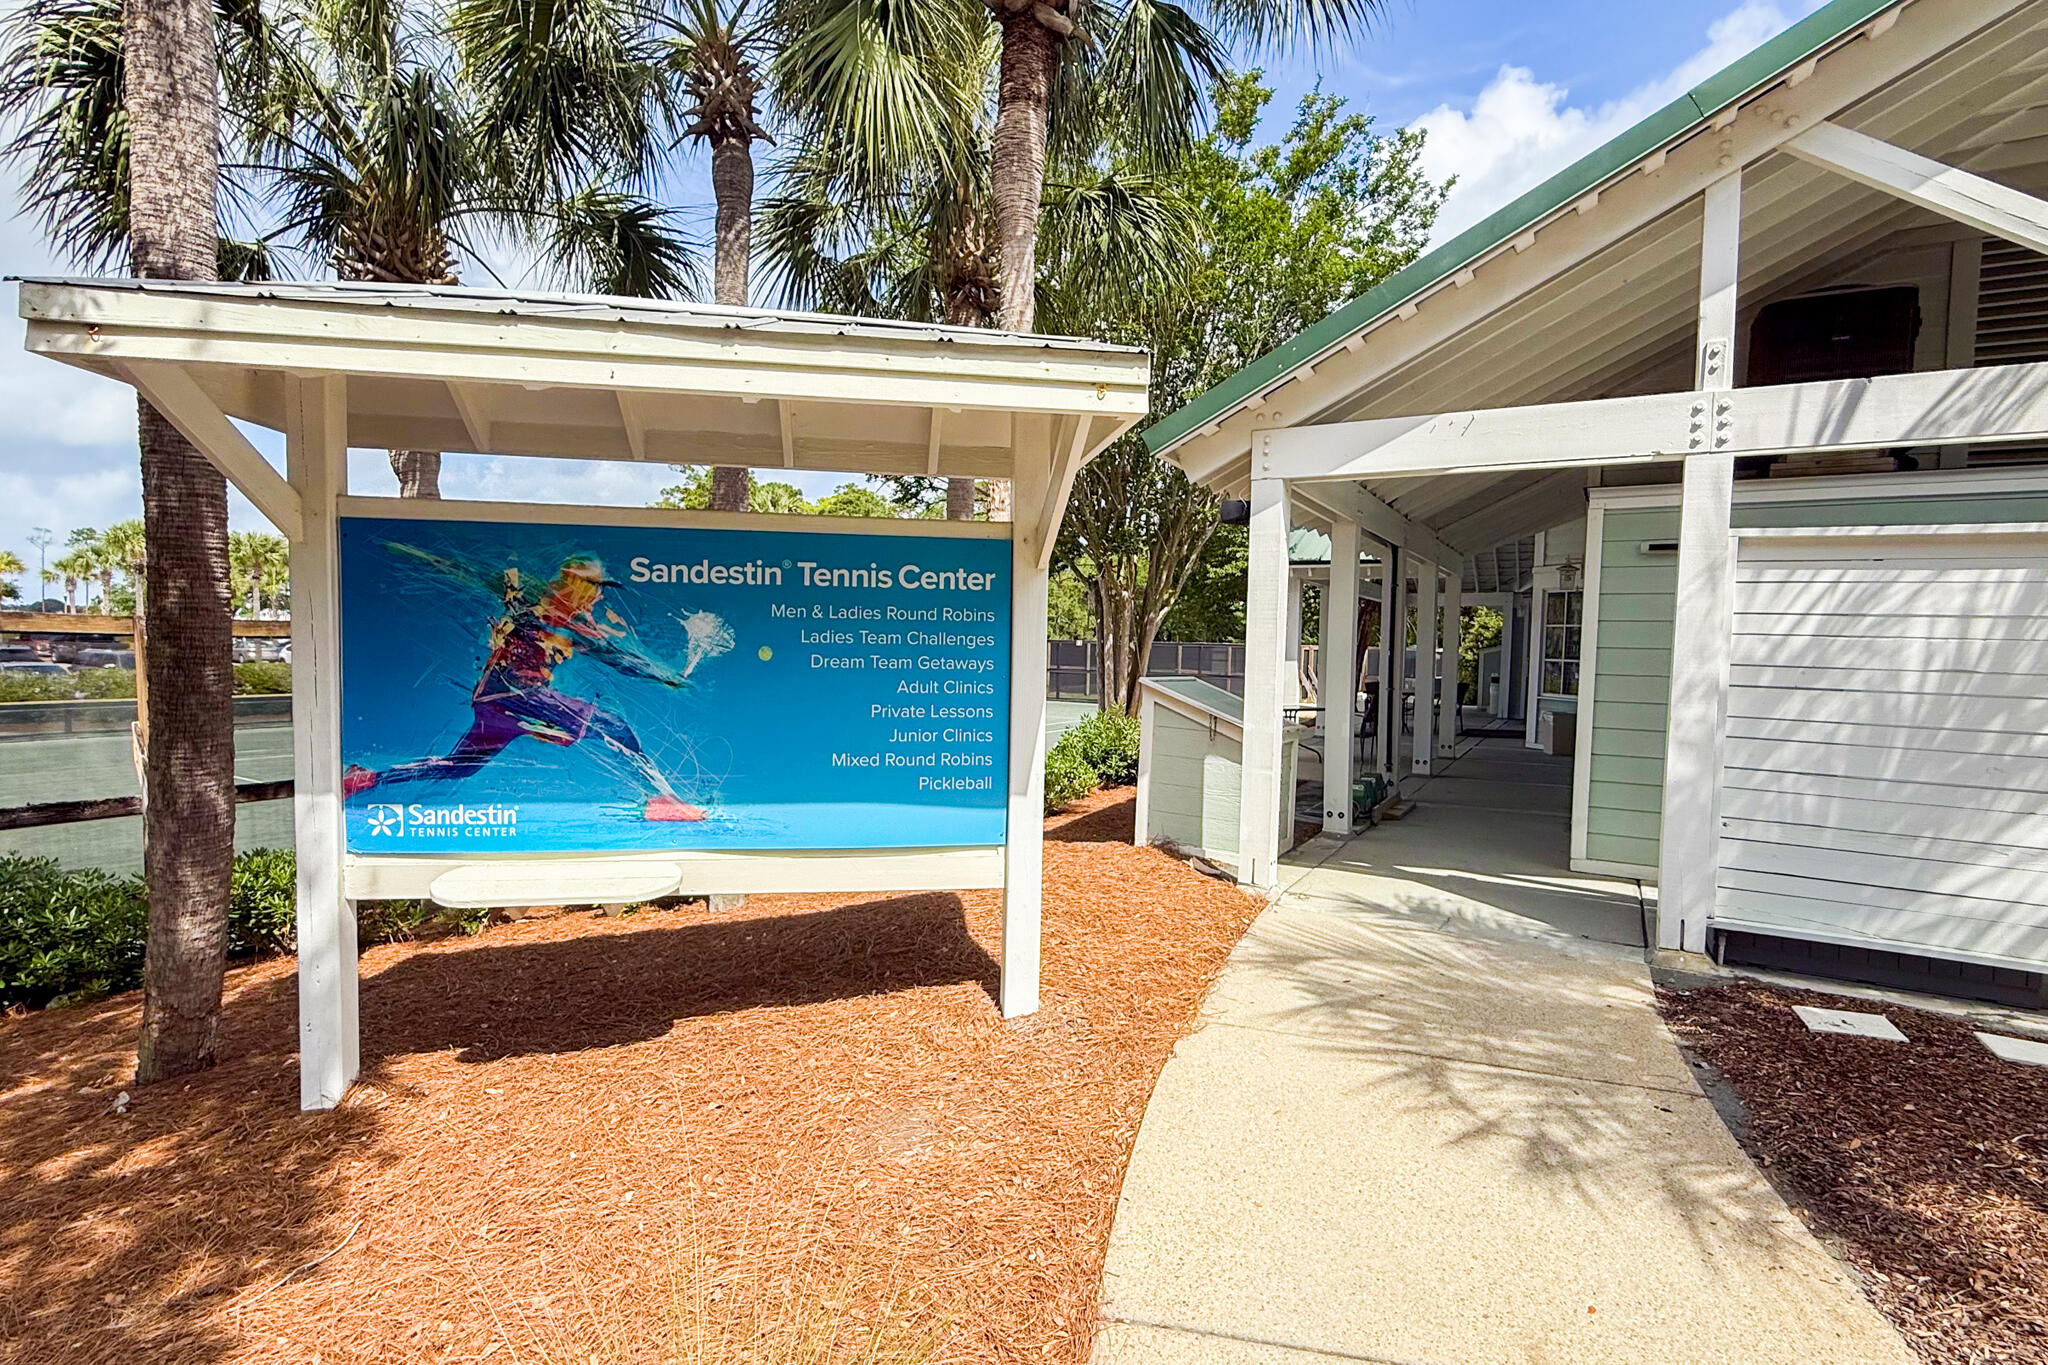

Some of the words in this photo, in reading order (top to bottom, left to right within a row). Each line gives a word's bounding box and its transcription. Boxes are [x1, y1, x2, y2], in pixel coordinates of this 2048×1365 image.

[798, 561, 892, 588] Tennis
[899, 565, 995, 591] Center
[771, 604, 806, 618] Men
[813, 605, 824, 619] &
[829, 605, 881, 620] Ladies
[887, 607, 937, 621] Round
[943, 608, 995, 622] Robins
[801, 630, 854, 644] Ladies
[859, 631, 902, 645] Team
[907, 631, 994, 649] Challenges
[811, 655, 864, 669] Dream
[870, 656, 912, 669] Team
[918, 656, 994, 672] Getaways
[897, 680, 938, 694] Adult
[943, 681, 993, 694] Clinics
[871, 705, 925, 718] Private
[931, 705, 993, 718] Lessons
[889, 729, 938, 743] Junior
[943, 729, 993, 743] Clinics
[832, 753, 879, 767] Mixed
[885, 753, 935, 767] Round
[941, 752, 992, 766] Robins
[920, 776, 992, 791] Pickleball
[409, 827, 458, 836] TENNIS
[465, 827, 516, 836] CENTER
